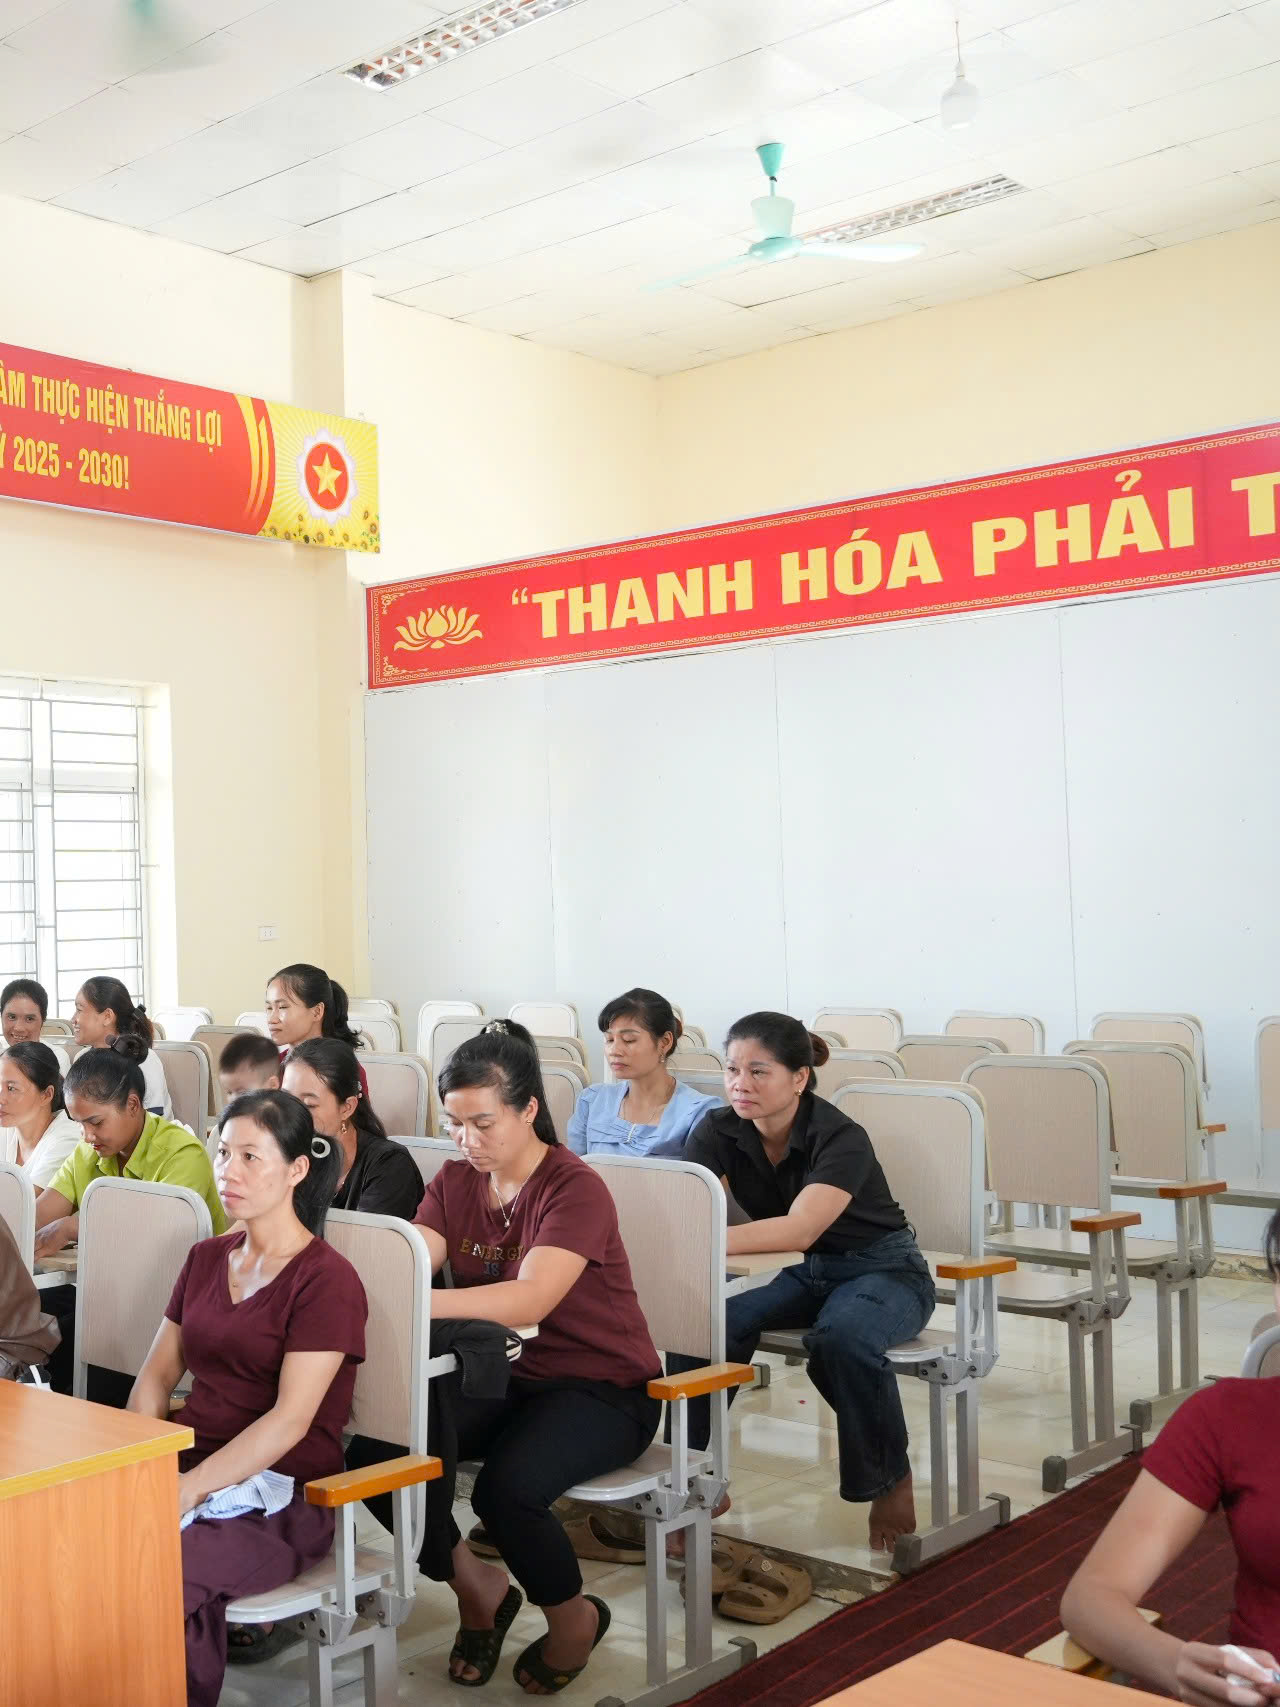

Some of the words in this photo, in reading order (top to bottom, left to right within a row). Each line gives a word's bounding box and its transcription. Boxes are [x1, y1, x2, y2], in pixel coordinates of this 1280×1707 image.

[31, 374, 81, 424] THỰC
[85, 384, 130, 434] HIỆN
[132, 389, 192, 442] THẮNG
[195, 408, 223, 453] LỢI
[12, 435, 61, 478] 2025
[65, 460, 73, 470] -
[78, 448, 130, 490] 2030!
[780, 528, 944, 605] HÓA
[971, 470, 1196, 577] PHẢI
